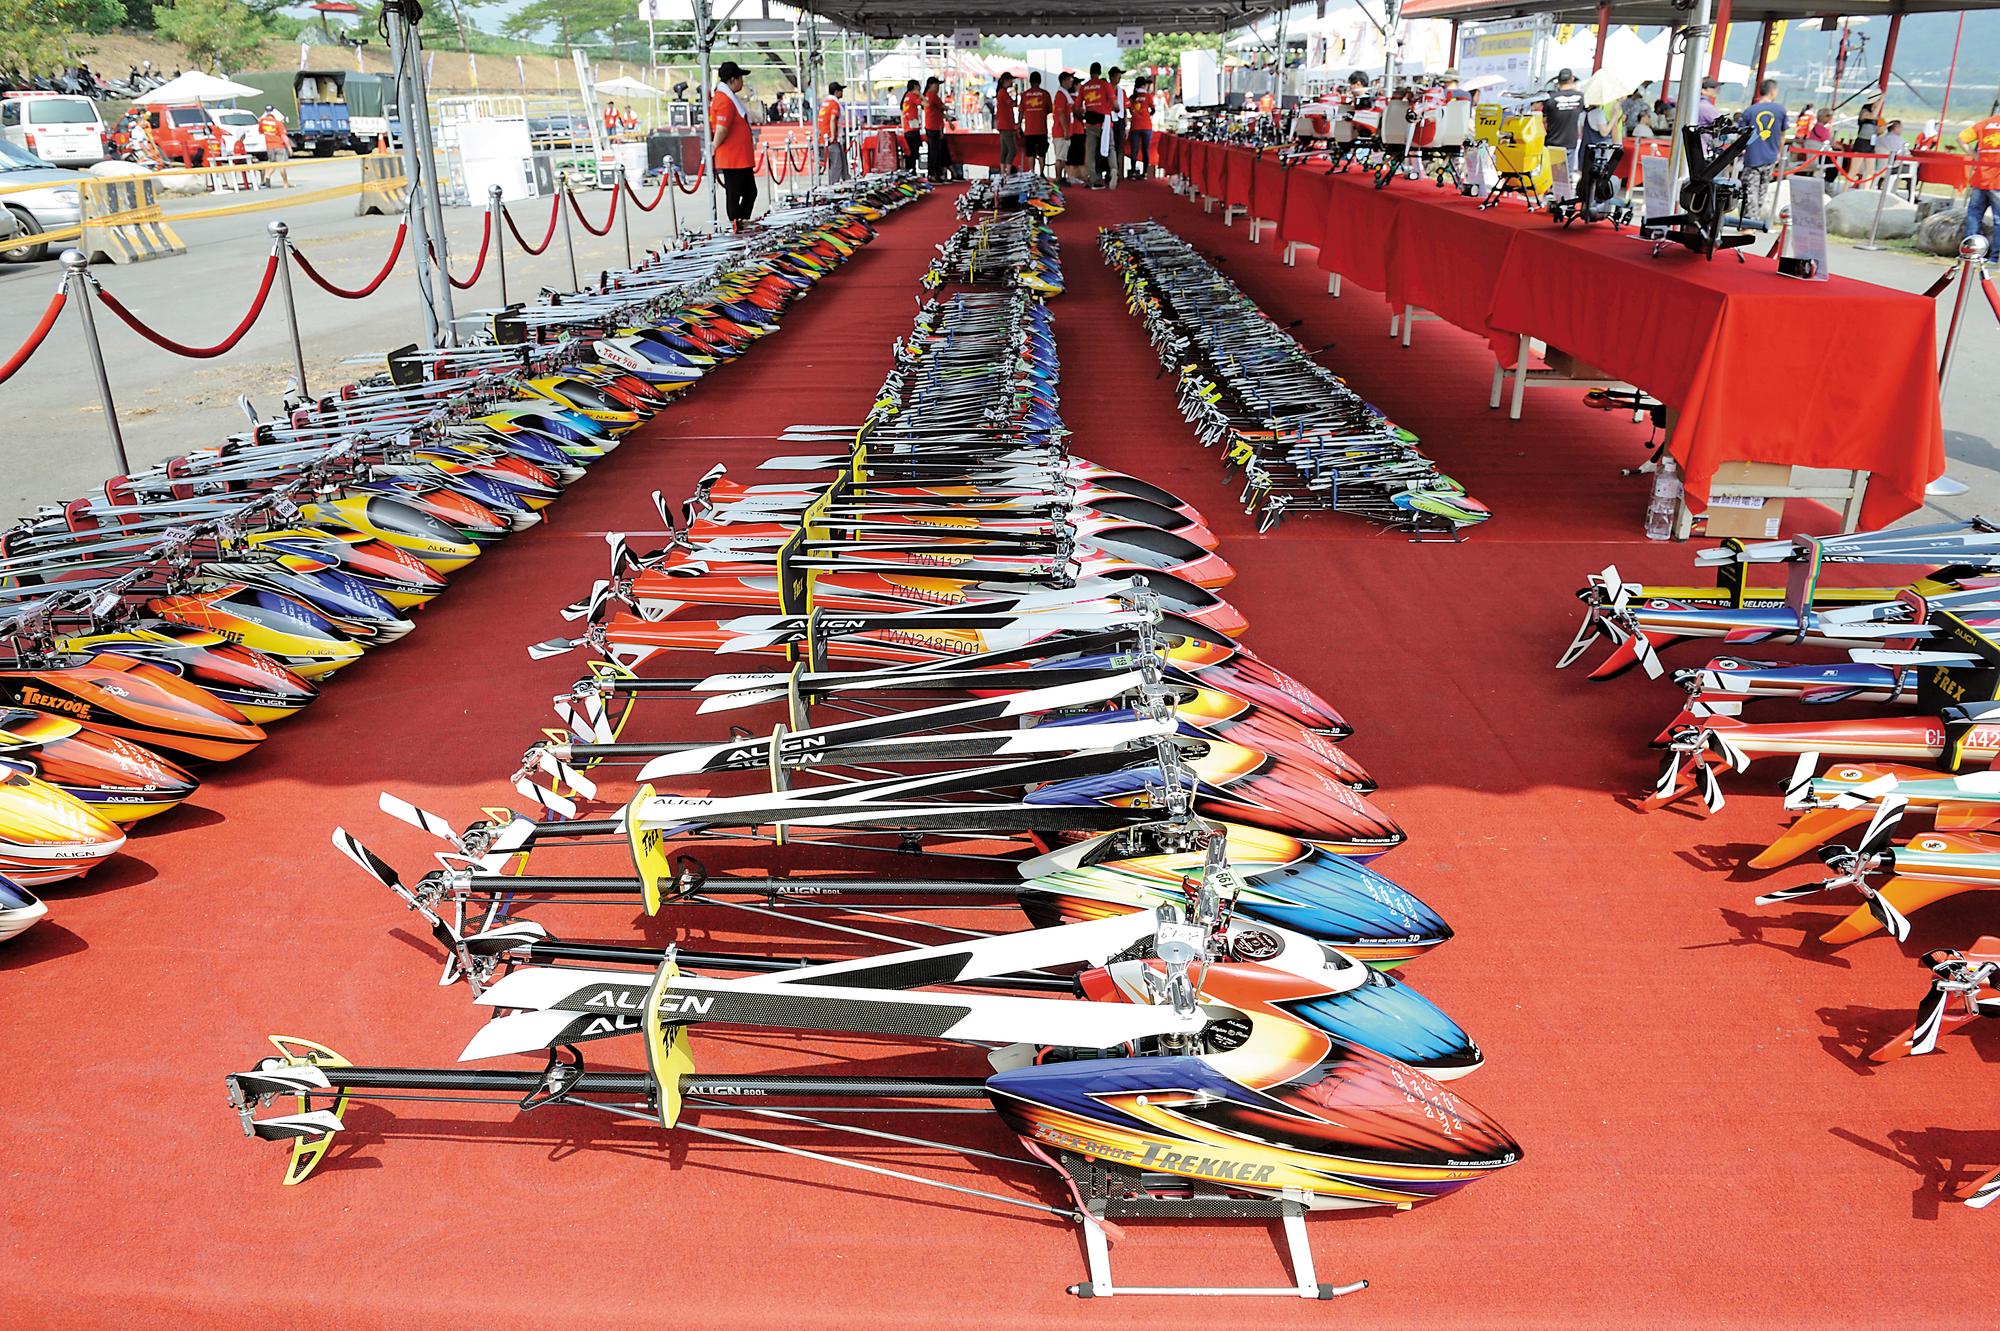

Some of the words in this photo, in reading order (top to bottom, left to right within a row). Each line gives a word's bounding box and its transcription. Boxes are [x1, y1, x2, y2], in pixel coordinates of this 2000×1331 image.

[427, 544, 456, 553] ALIGN
[1955, 628, 1978, 647] ALIGN
[21, 685, 91, 716] TREX700E
[254, 698, 287, 706] ALIGN
[726, 735, 827, 762] ALGN
[653, 798, 713, 806] ALIGN
[55, 850, 96, 858] ALIGN
[776, 886, 821, 895] ALIGN
[1408, 934, 1420, 942] 3D
[686, 1085, 741, 1096] ALIGN
[743, 1088, 768, 1096] 800L
[1139, 1140, 1276, 1183] TREKKER
[1503, 1152, 1515, 1164] 3D
